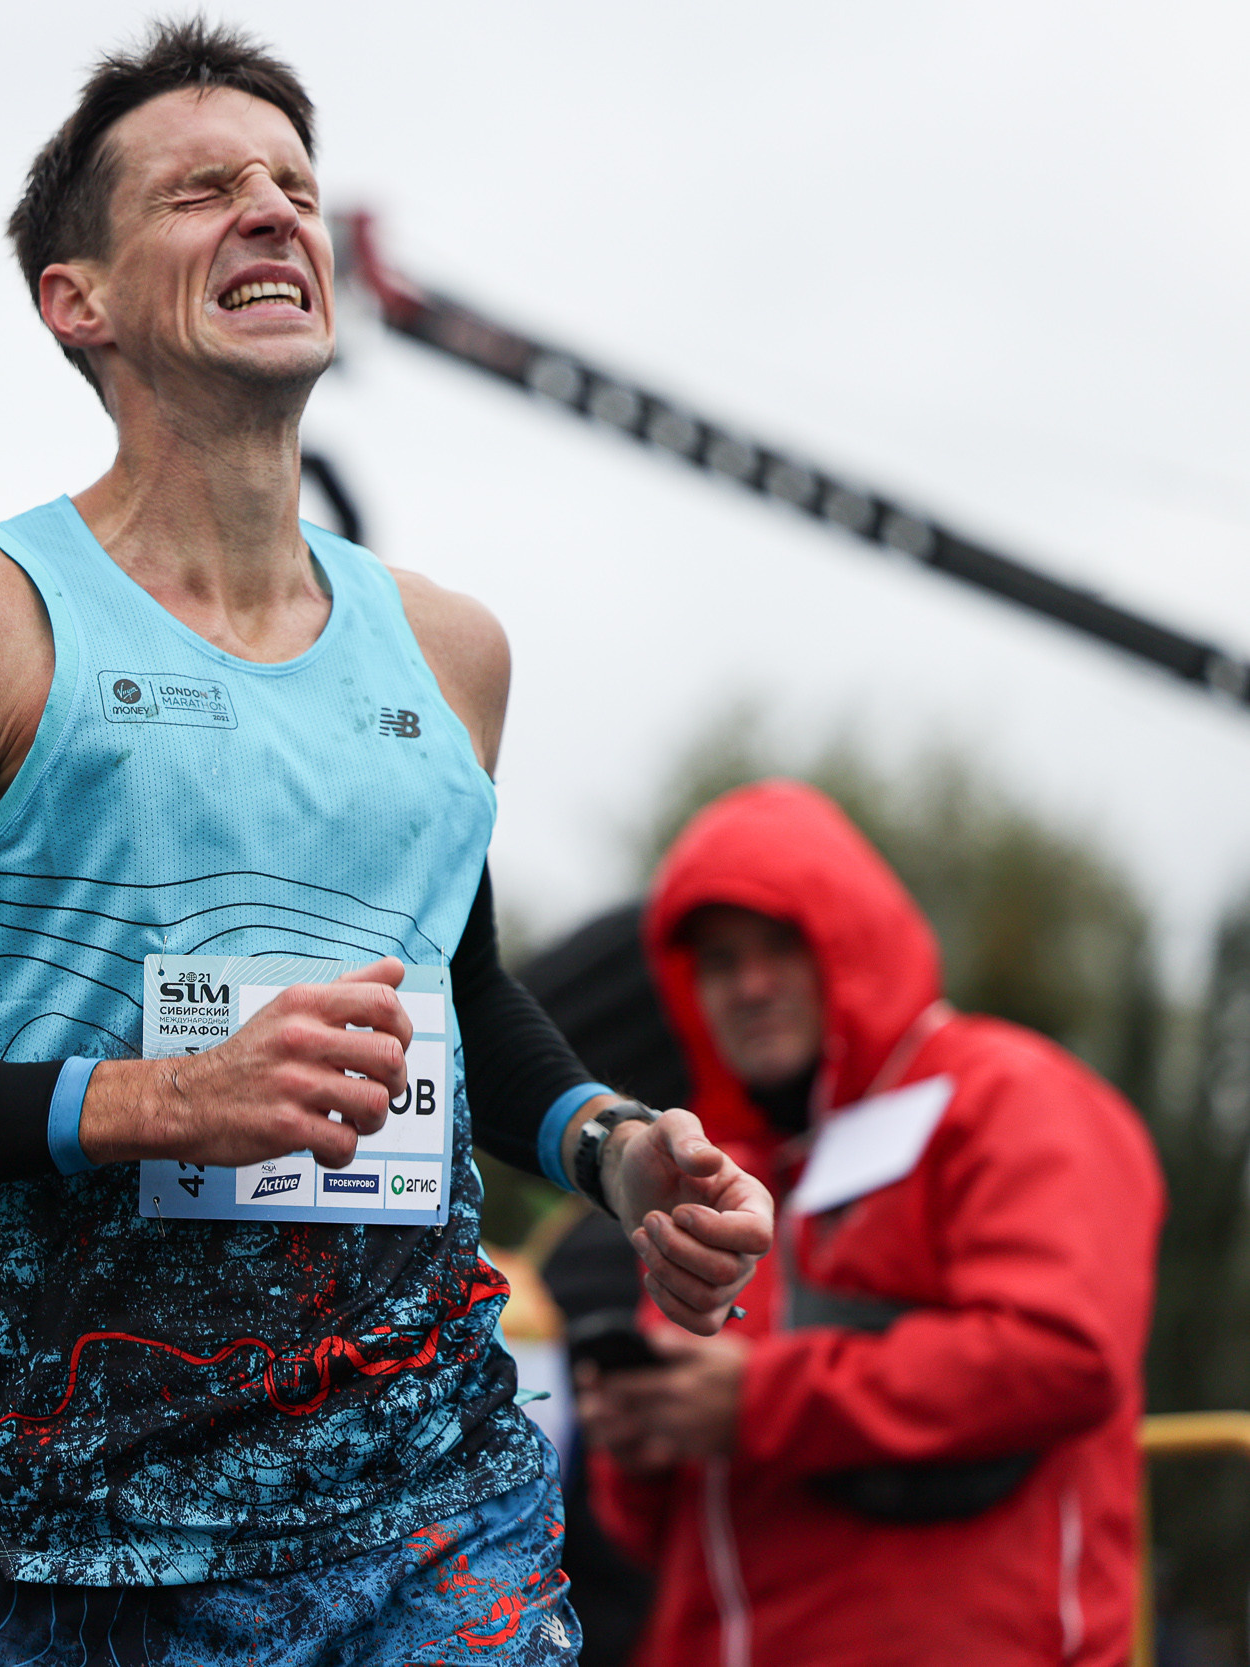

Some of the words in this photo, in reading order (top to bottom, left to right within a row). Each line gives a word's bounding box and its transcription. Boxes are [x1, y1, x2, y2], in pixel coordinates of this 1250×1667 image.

[159, 686, 208, 700] LONDON
[162, 696, 227, 711] MARATHON
[112, 706, 150, 715] MONEY
[159, 1006, 230, 1016] СИБИРСКИЙ
[159, 1016, 230, 1025] МЕЖДУНАРОДНЫЙ
[159, 1024, 229, 1036] МАРАФОН
[257, 1176, 298, 1193] Active
[328, 1178, 376, 1189] ТРОЕКУРОВО
[406, 1178, 437, 1193] 2ГИС
